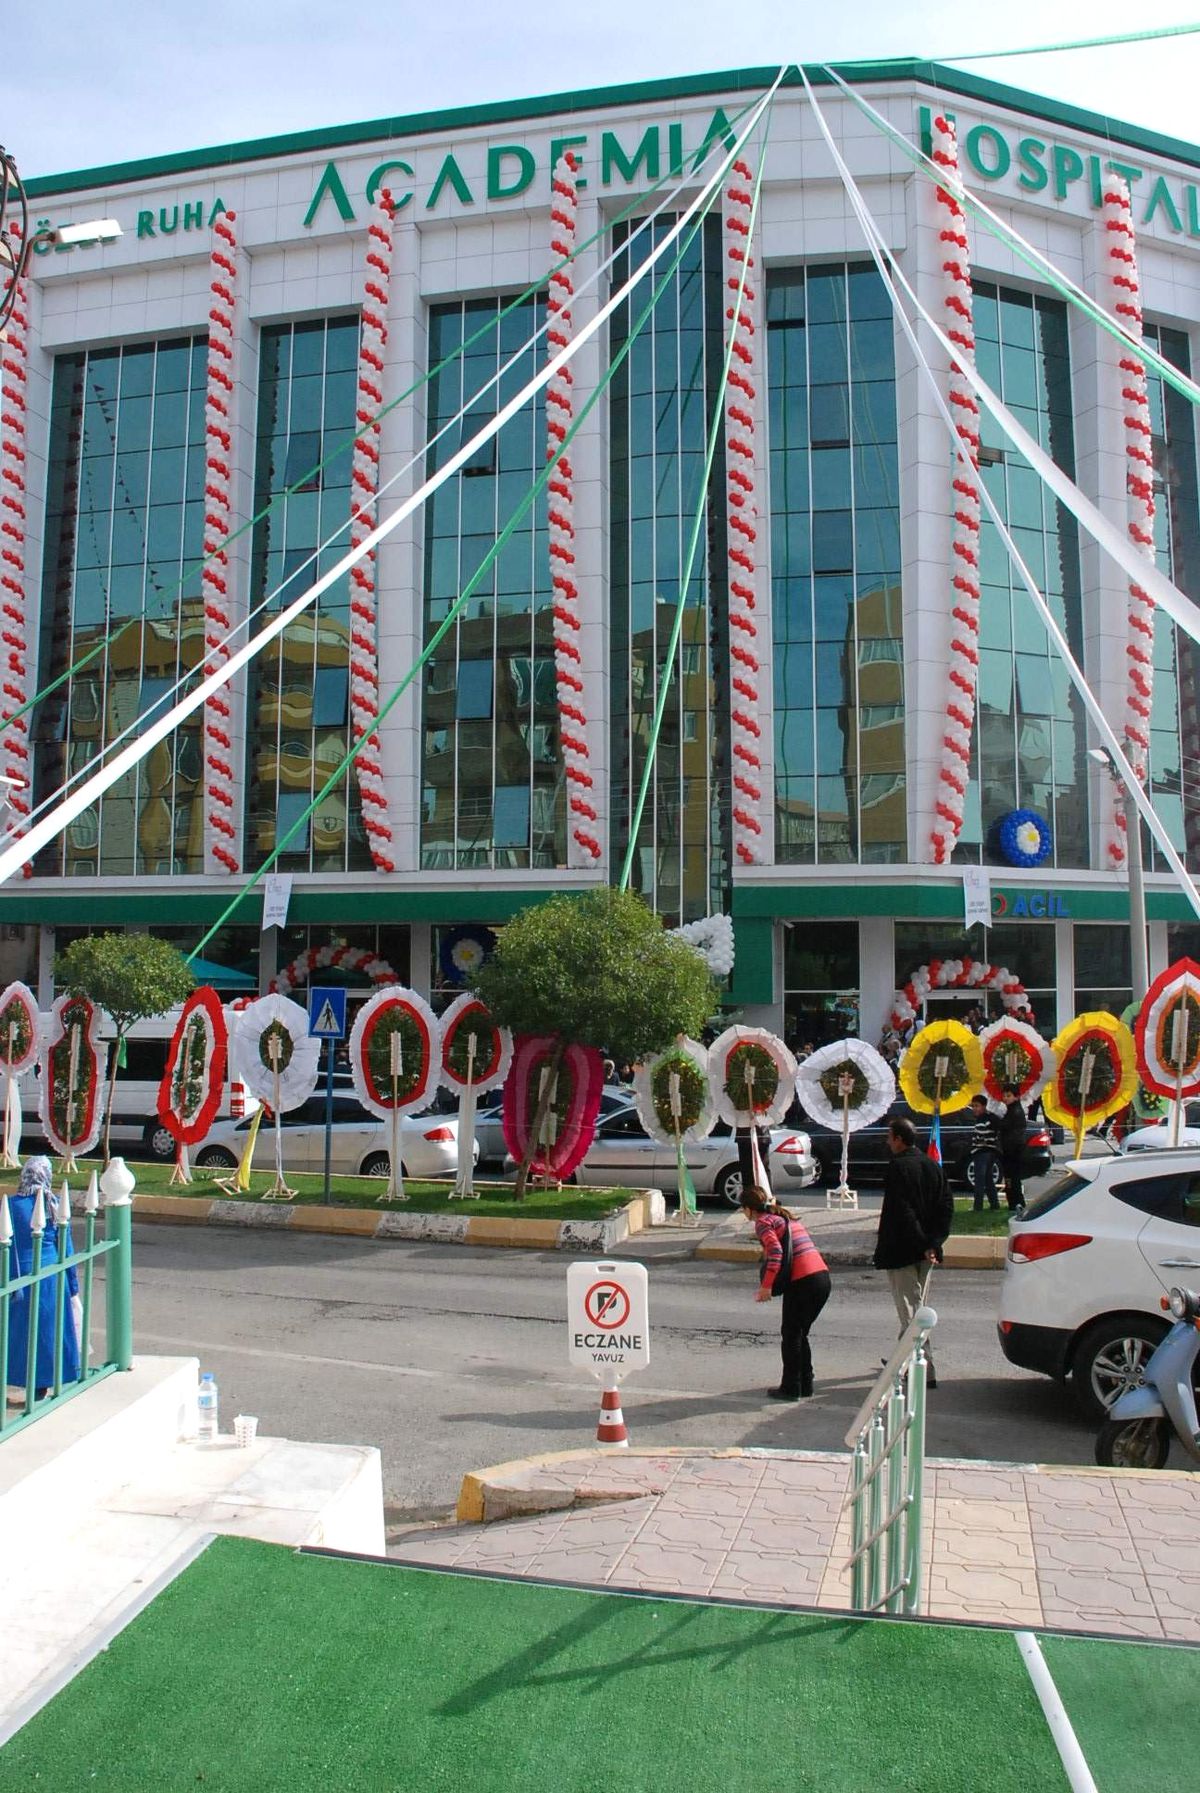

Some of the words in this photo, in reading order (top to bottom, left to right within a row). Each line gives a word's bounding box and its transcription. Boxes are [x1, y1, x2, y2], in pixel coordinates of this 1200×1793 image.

[137, 197, 227, 239] RUHA
[303, 107, 742, 227] ACADEMIA
[574, 1333, 642, 1349] ECZANE
[591, 1353, 624, 1363] YAVUZ
